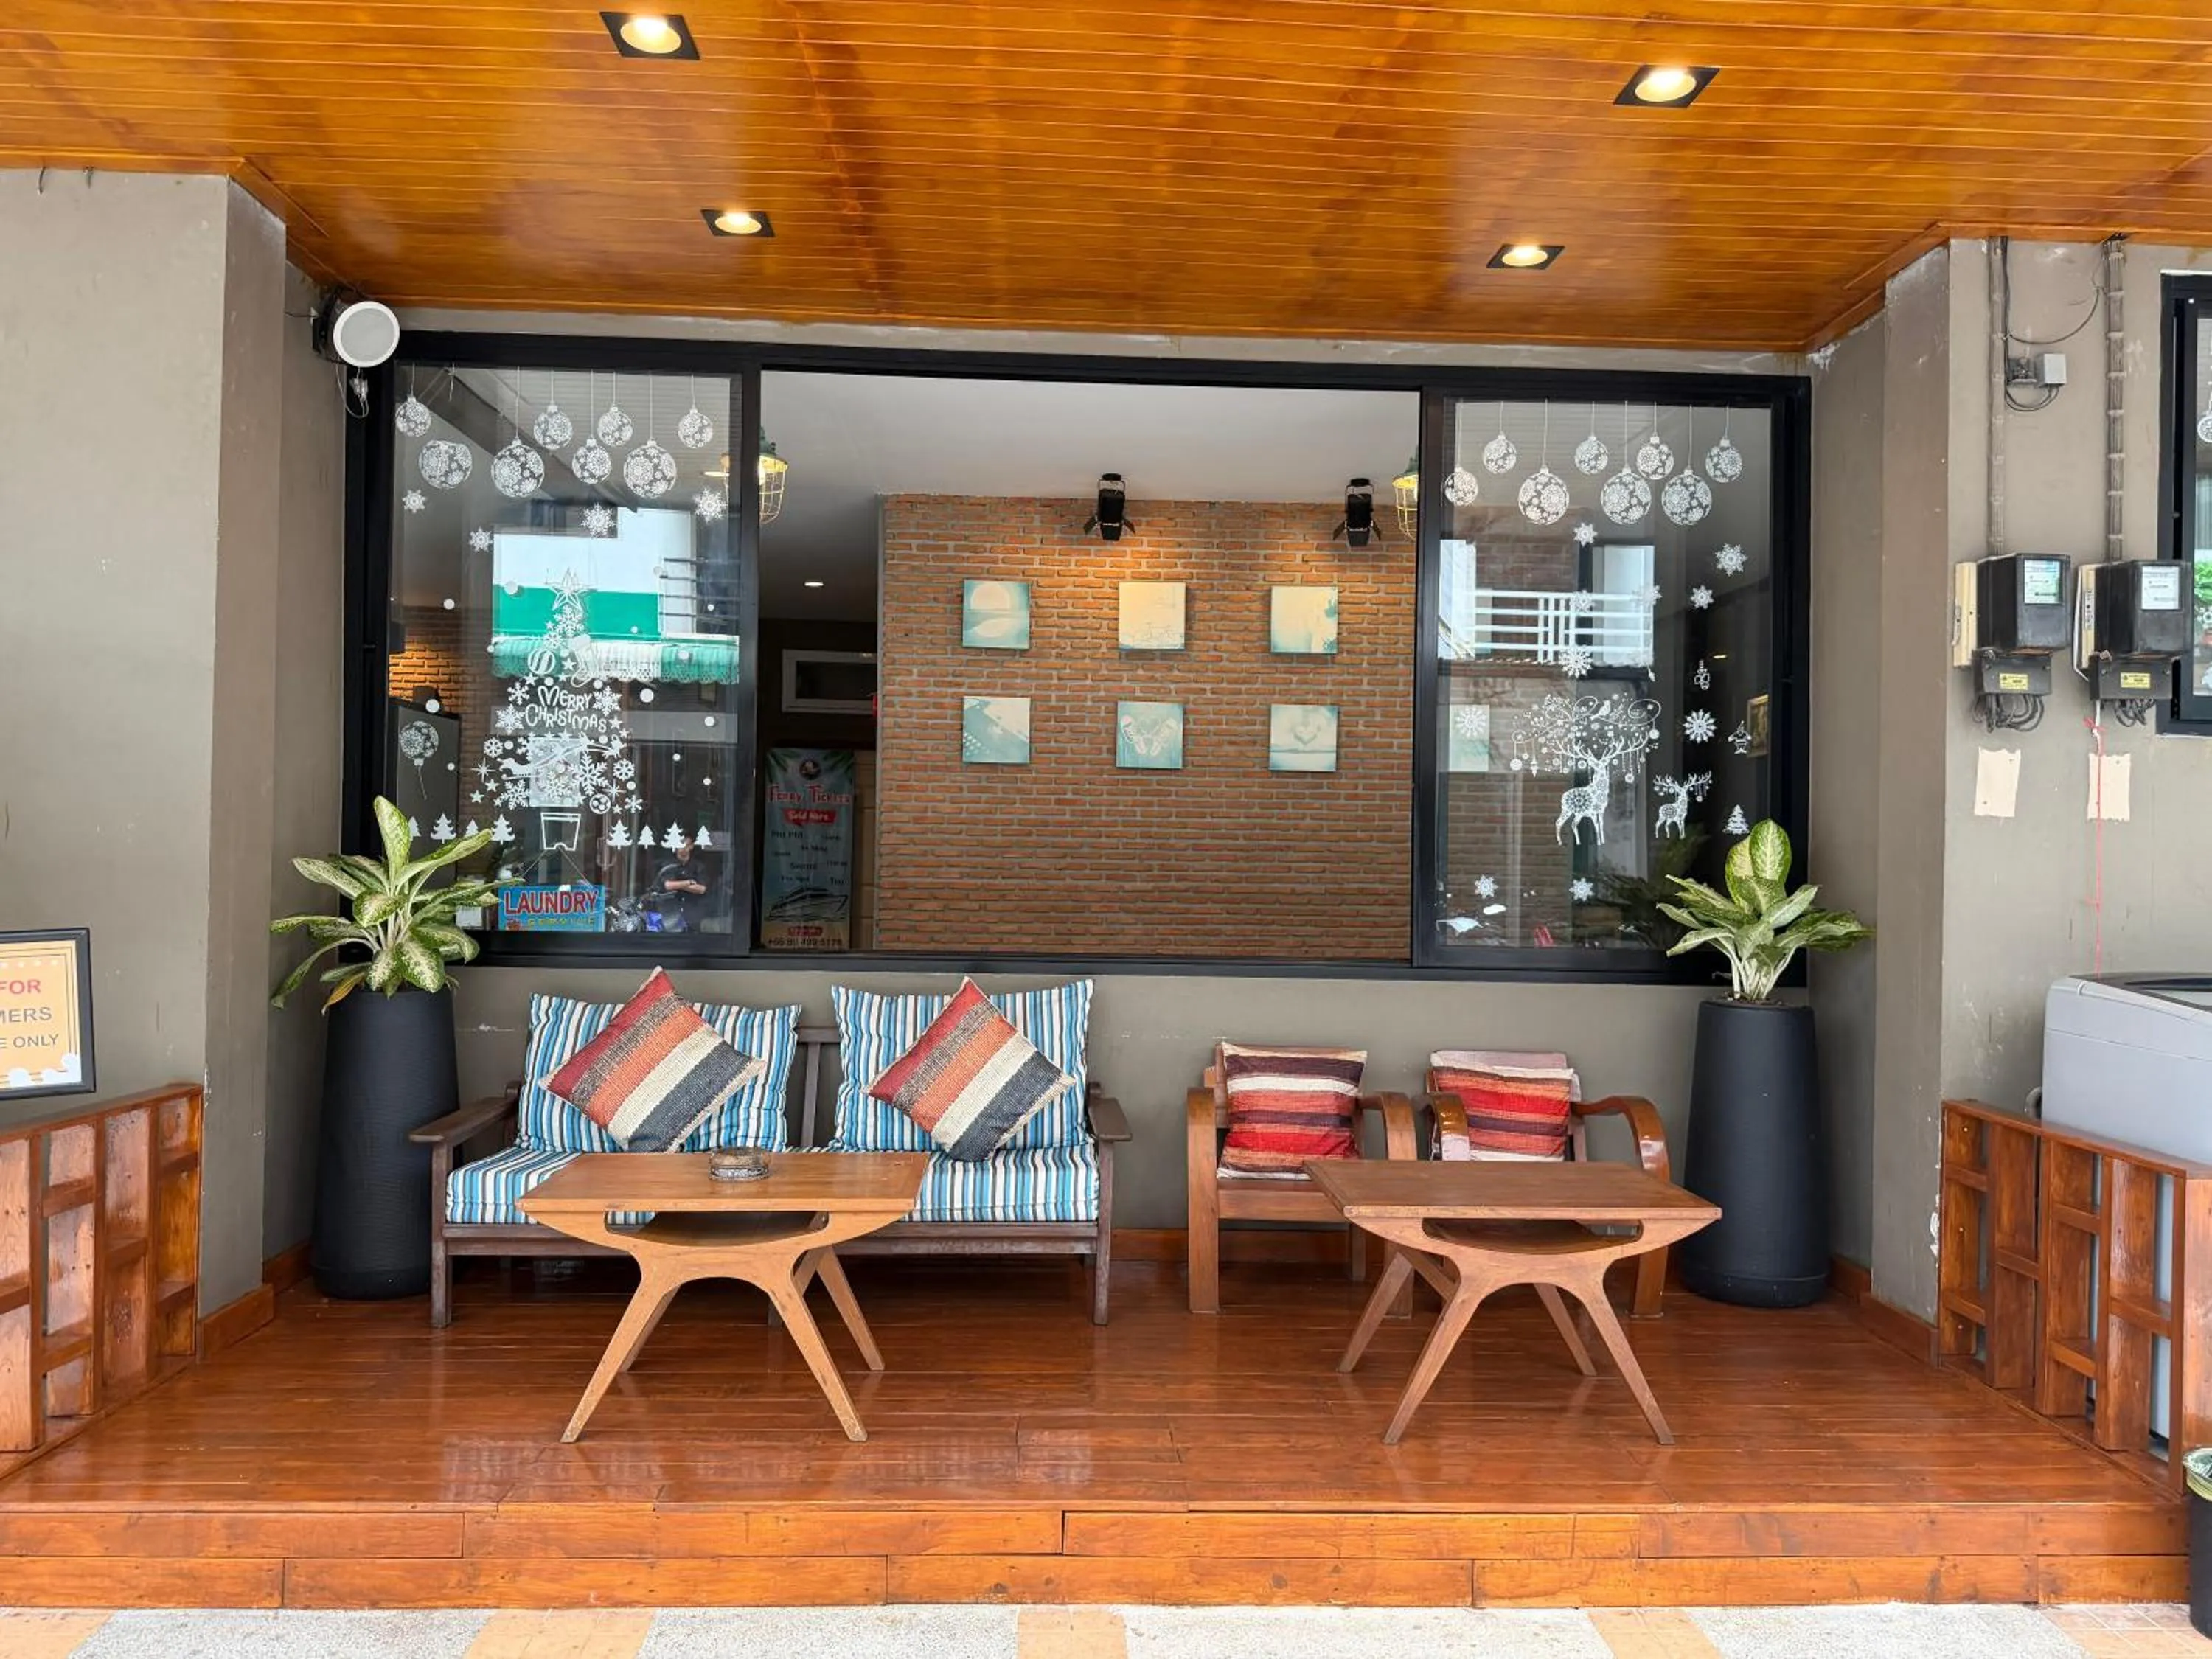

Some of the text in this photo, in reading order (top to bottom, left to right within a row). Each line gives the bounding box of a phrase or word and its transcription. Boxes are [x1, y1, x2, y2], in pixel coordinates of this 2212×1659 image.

[538, 686, 592, 710] MERRY
[525, 704, 607, 732] CHRISTMAS
[504, 890, 599, 915] LAUNDRY
[13, 1033, 59, 1048] ONLY
